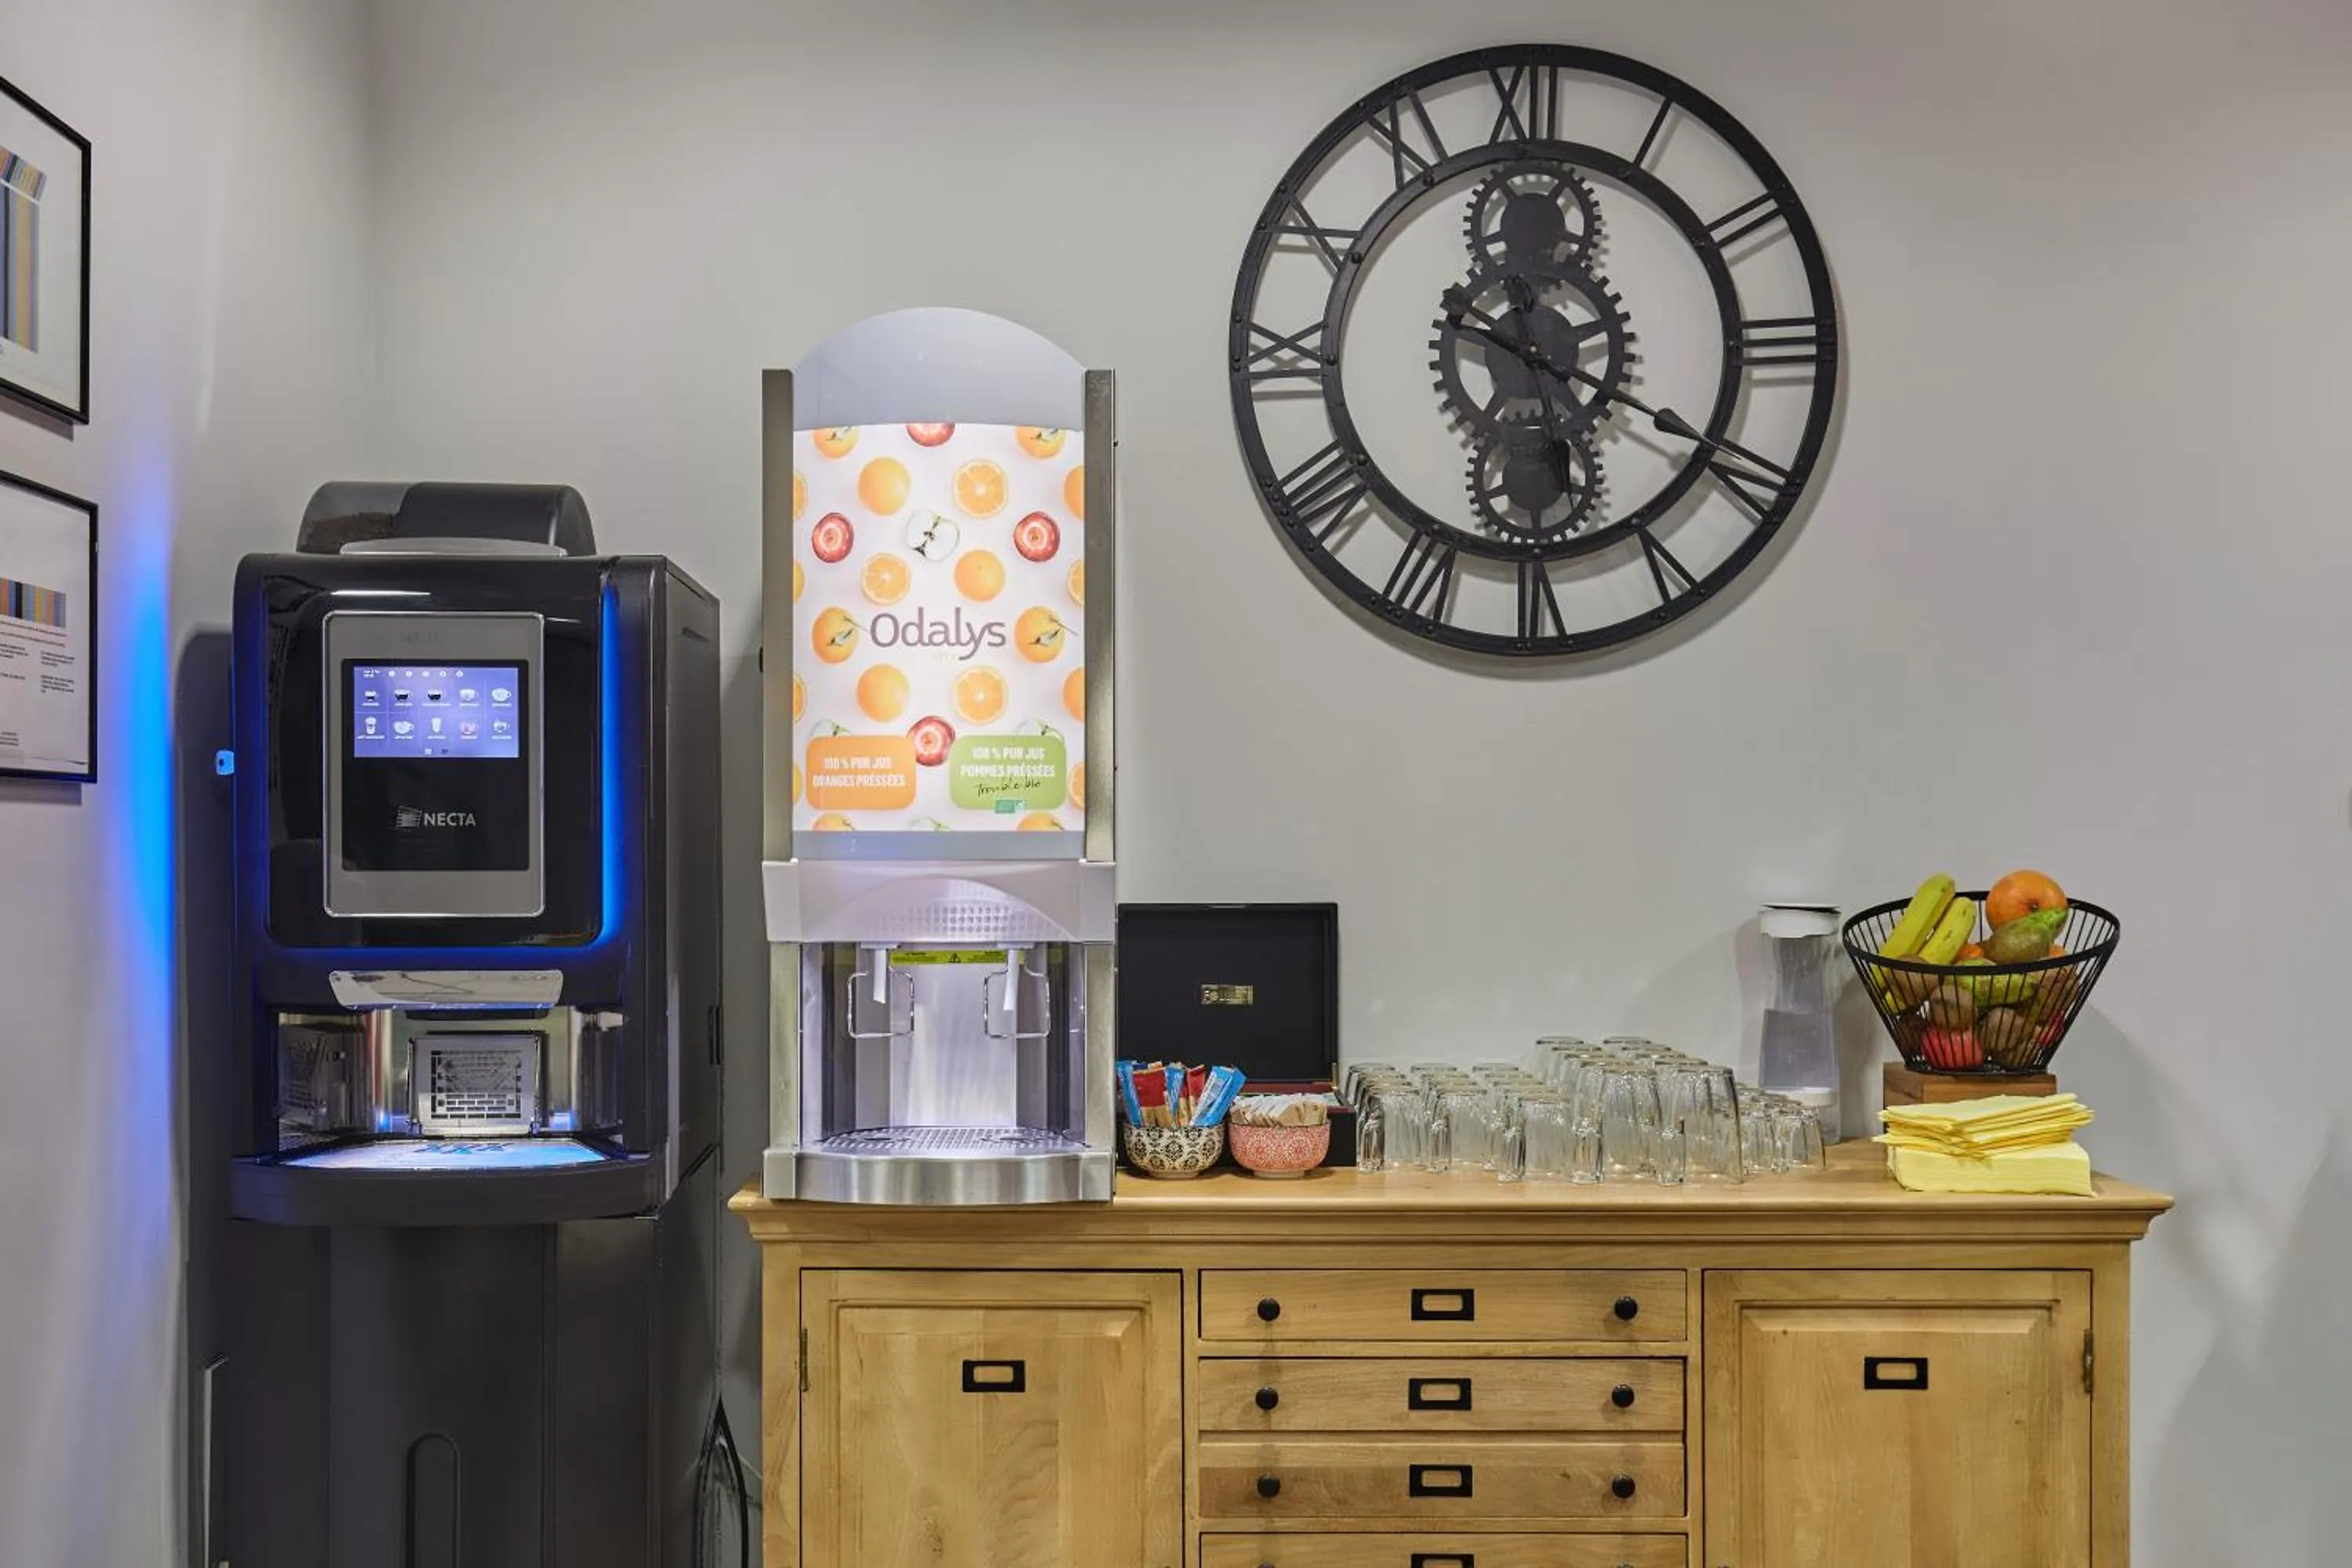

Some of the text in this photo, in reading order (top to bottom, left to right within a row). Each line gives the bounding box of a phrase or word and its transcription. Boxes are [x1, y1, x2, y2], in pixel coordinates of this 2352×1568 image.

[870, 607, 1006, 660] Odalys
[1003, 747, 1023, 760] PUR
[1025, 747, 1045, 760] JUS
[851, 757, 870, 769] PUR
[872, 757, 892, 769] JUS
[960, 764, 1004, 777] POMMES
[812, 773, 855, 787] ORANGES
[424, 812, 476, 826] NECTA
